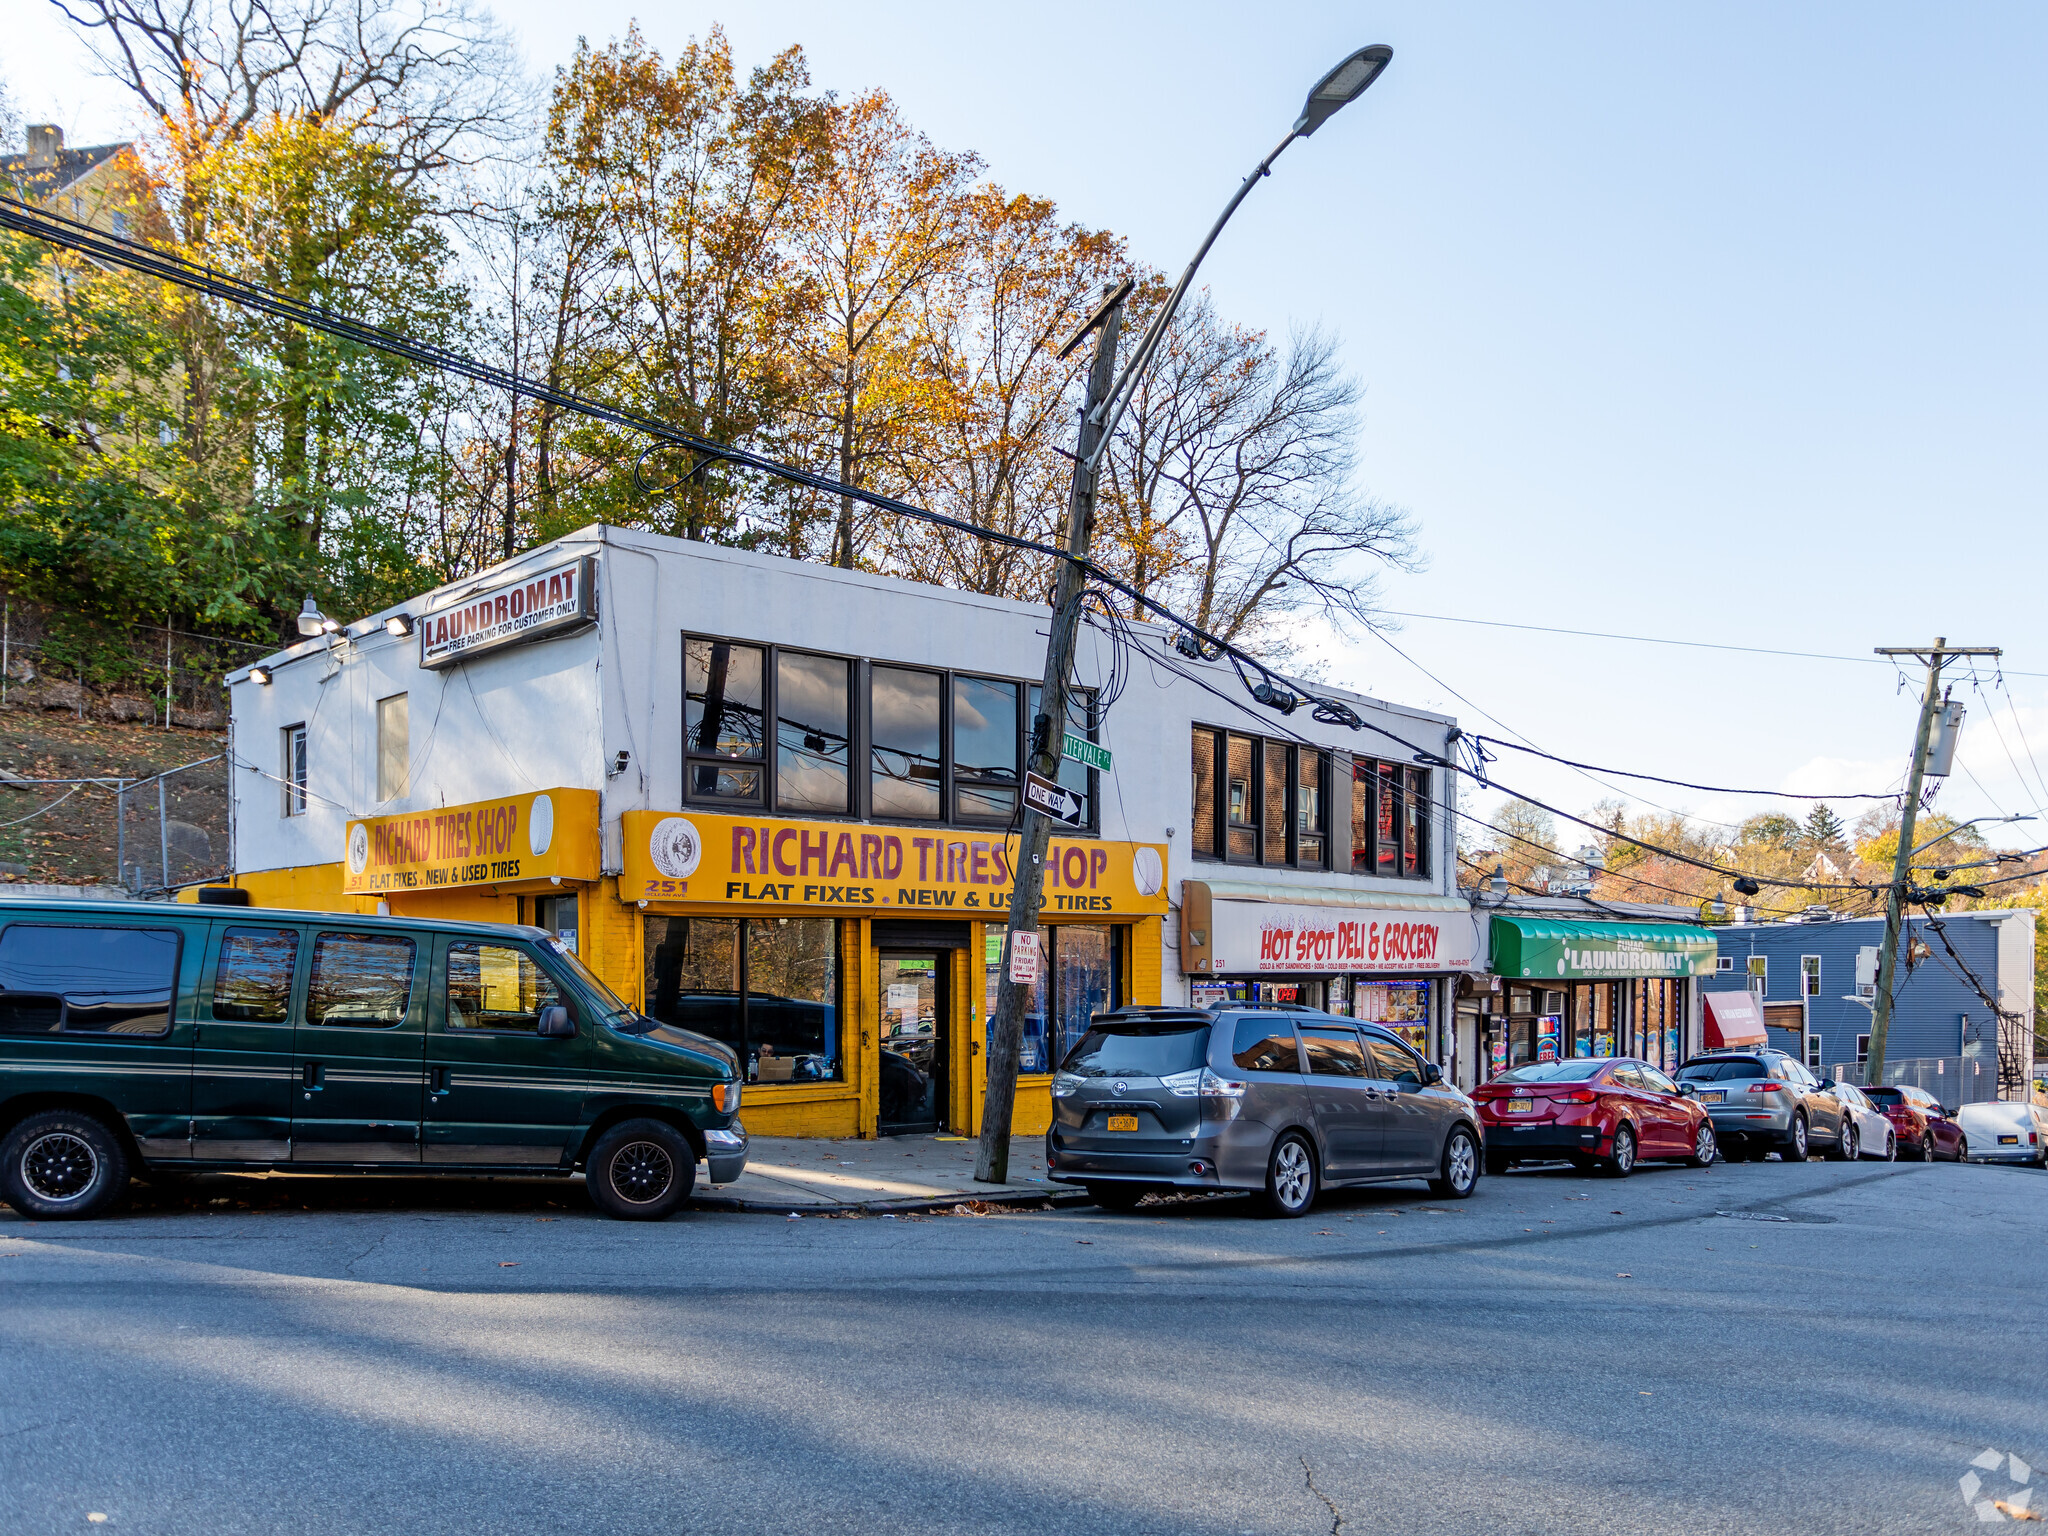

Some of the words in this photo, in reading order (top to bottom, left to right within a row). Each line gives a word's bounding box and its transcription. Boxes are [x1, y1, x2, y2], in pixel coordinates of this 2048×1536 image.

[425, 568, 577, 648] LAUNDROMAT
[449, 637, 466, 652] FREE
[467, 627, 497, 647] PARKING
[498, 621, 512, 637] FOR
[514, 606, 554, 630] CUSTOMER
[556, 599, 577, 617] ONLY
[1063, 736, 1102, 767] NTERVALE
[1103, 751, 1110, 764] PL
[1030, 785, 1046, 802] ONE
[1048, 791, 1065, 810] WAY
[374, 818, 431, 866] RICHARD
[435, 811, 472, 860] TIRES
[475, 805, 518, 857] SHOP
[731, 826, 903, 881] RICHARD
[912, 837, 1008, 886] TIRES
[1043, 846, 1108, 890] HOP
[370, 873, 391, 889] FLAT
[393, 871, 418, 887] FIXES
[425, 868, 449, 885] NEW
[451, 867, 459, 883] &
[461, 863, 488, 882] USED
[491, 860, 520, 878] TIRES
[645, 880, 688, 893] 251
[726, 882, 795, 902] FLAT
[804, 885, 875, 904] FIXES
[898, 889, 956, 906] NEW
[963, 891, 980, 907] &
[989, 892, 1047, 909] USD
[1054, 895, 1112, 911] TIRES
[1014, 945, 1036, 956] PARKING
[1020, 935, 1031, 945] NO
[1260, 928, 1293, 961] HOT
[1296, 930, 1335, 961] SPOT
[1337, 921, 1365, 960] DELI
[1368, 921, 1380, 961] &
[1383, 922, 1439, 961] GROCERY
[1015, 956, 1034, 965] FRIDAY
[1215, 959, 1225, 967] 251
[1571, 950, 1683, 970] LAUNDROMAT
[1278, 988, 1298, 1001] OPEN
[1539, 1051, 1555, 1061] FREE
